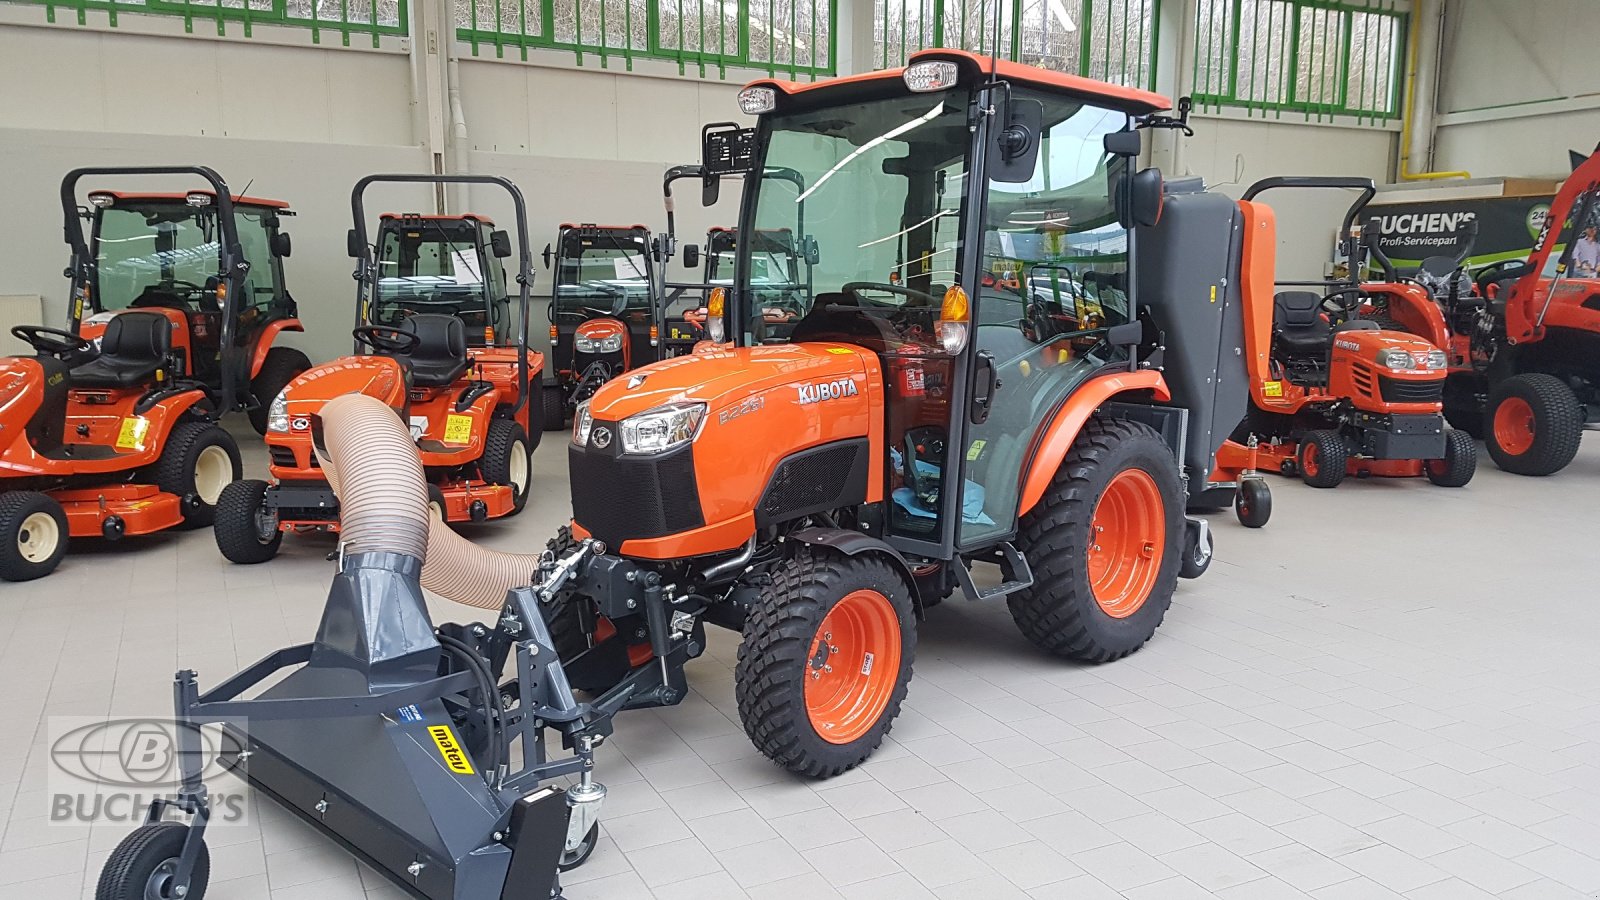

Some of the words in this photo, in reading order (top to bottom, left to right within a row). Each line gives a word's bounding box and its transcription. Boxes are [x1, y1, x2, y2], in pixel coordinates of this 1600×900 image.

[1371, 212, 1475, 234] UCHEN'S
[797, 378, 859, 405] KUBOTA
[432, 728, 467, 770] matev
